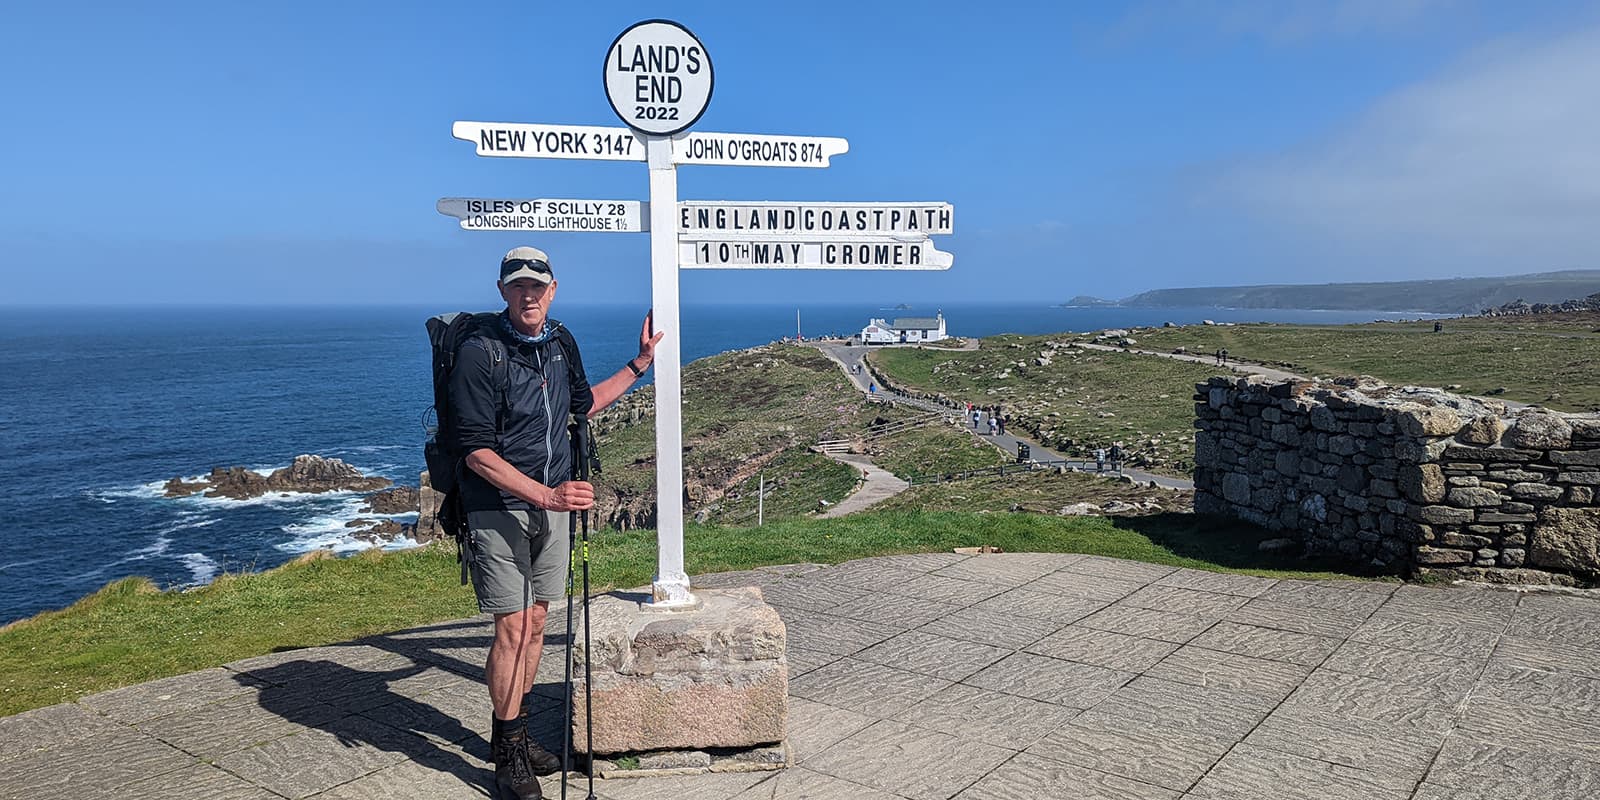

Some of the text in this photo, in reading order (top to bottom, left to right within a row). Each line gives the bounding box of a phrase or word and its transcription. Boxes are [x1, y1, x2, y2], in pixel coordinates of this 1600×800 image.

[618, 44, 700, 74] LAND'S
[636, 75, 682, 103] END
[635, 106, 679, 120] 2022
[480, 129, 634, 155] NEW YORK 3147
[685, 138, 823, 163] JOHN O'GROATS 874
[467, 200, 625, 216] ISLES OF SCILLY 28
[467, 215, 535, 229] LONGSHIPS
[538, 216, 612, 230] LIGHTHOUSE
[701, 242, 921, 265] 10TH MAY CROMER
